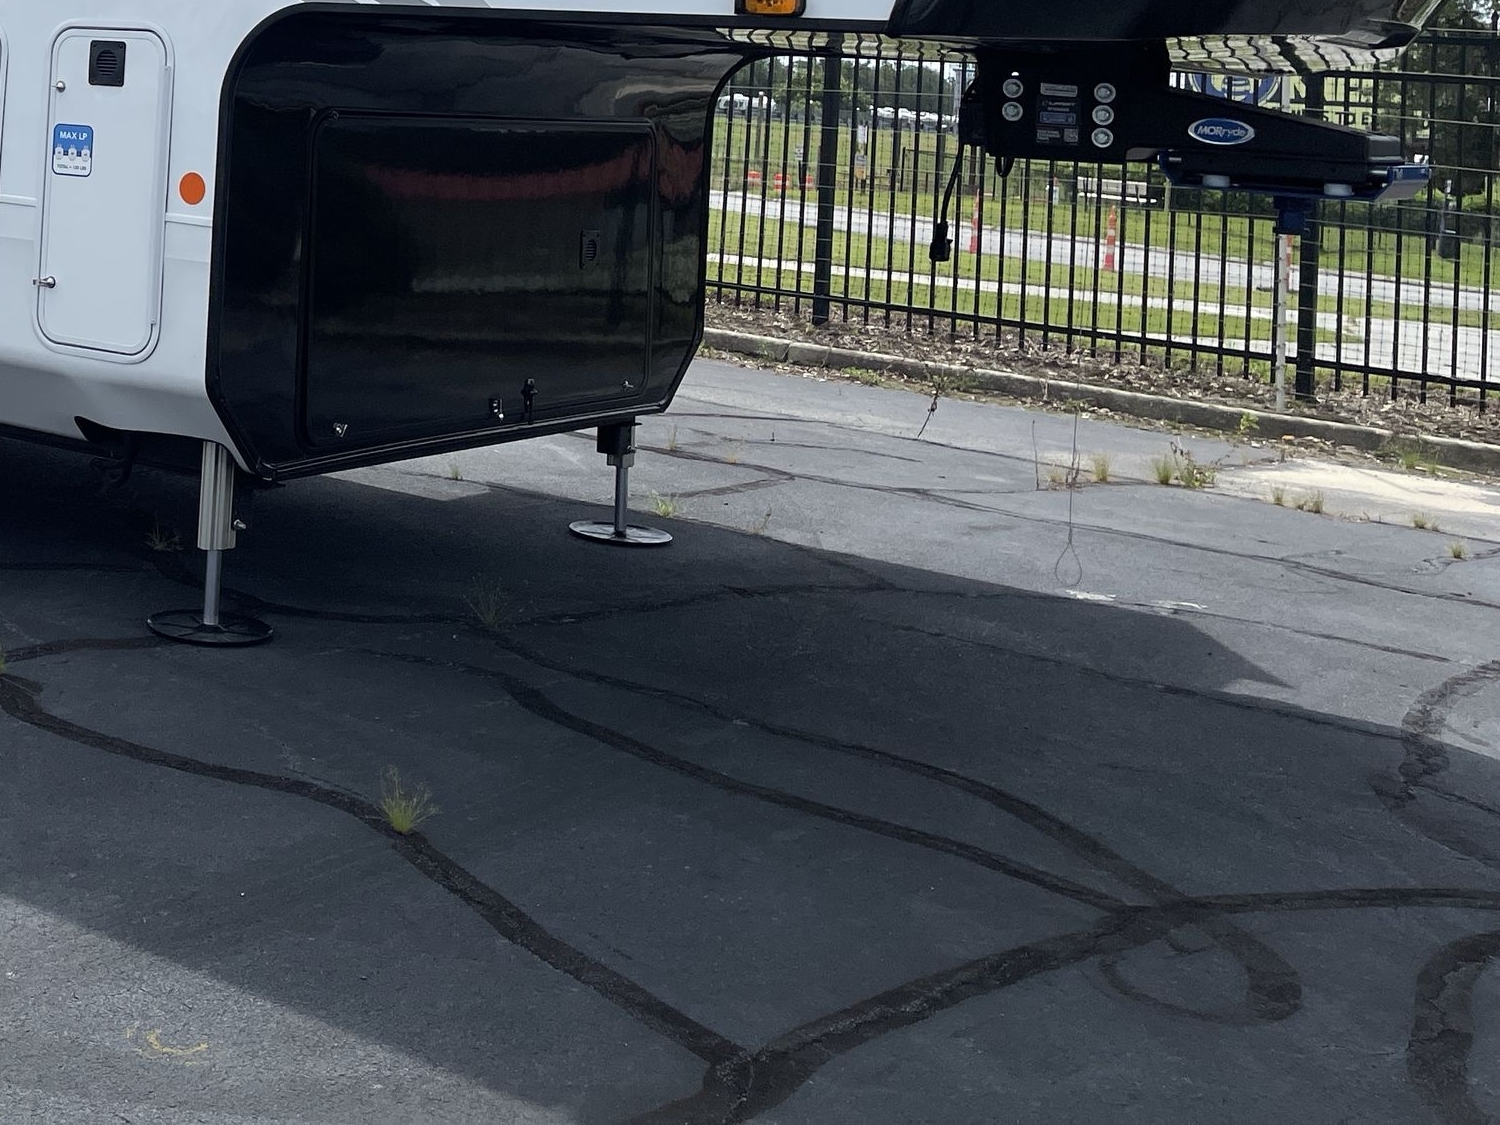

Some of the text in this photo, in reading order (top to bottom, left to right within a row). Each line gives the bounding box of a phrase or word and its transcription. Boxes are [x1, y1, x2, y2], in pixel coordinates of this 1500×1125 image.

[59, 131, 88, 141] MAX LP
[1197, 125, 1247, 138] MORryde
